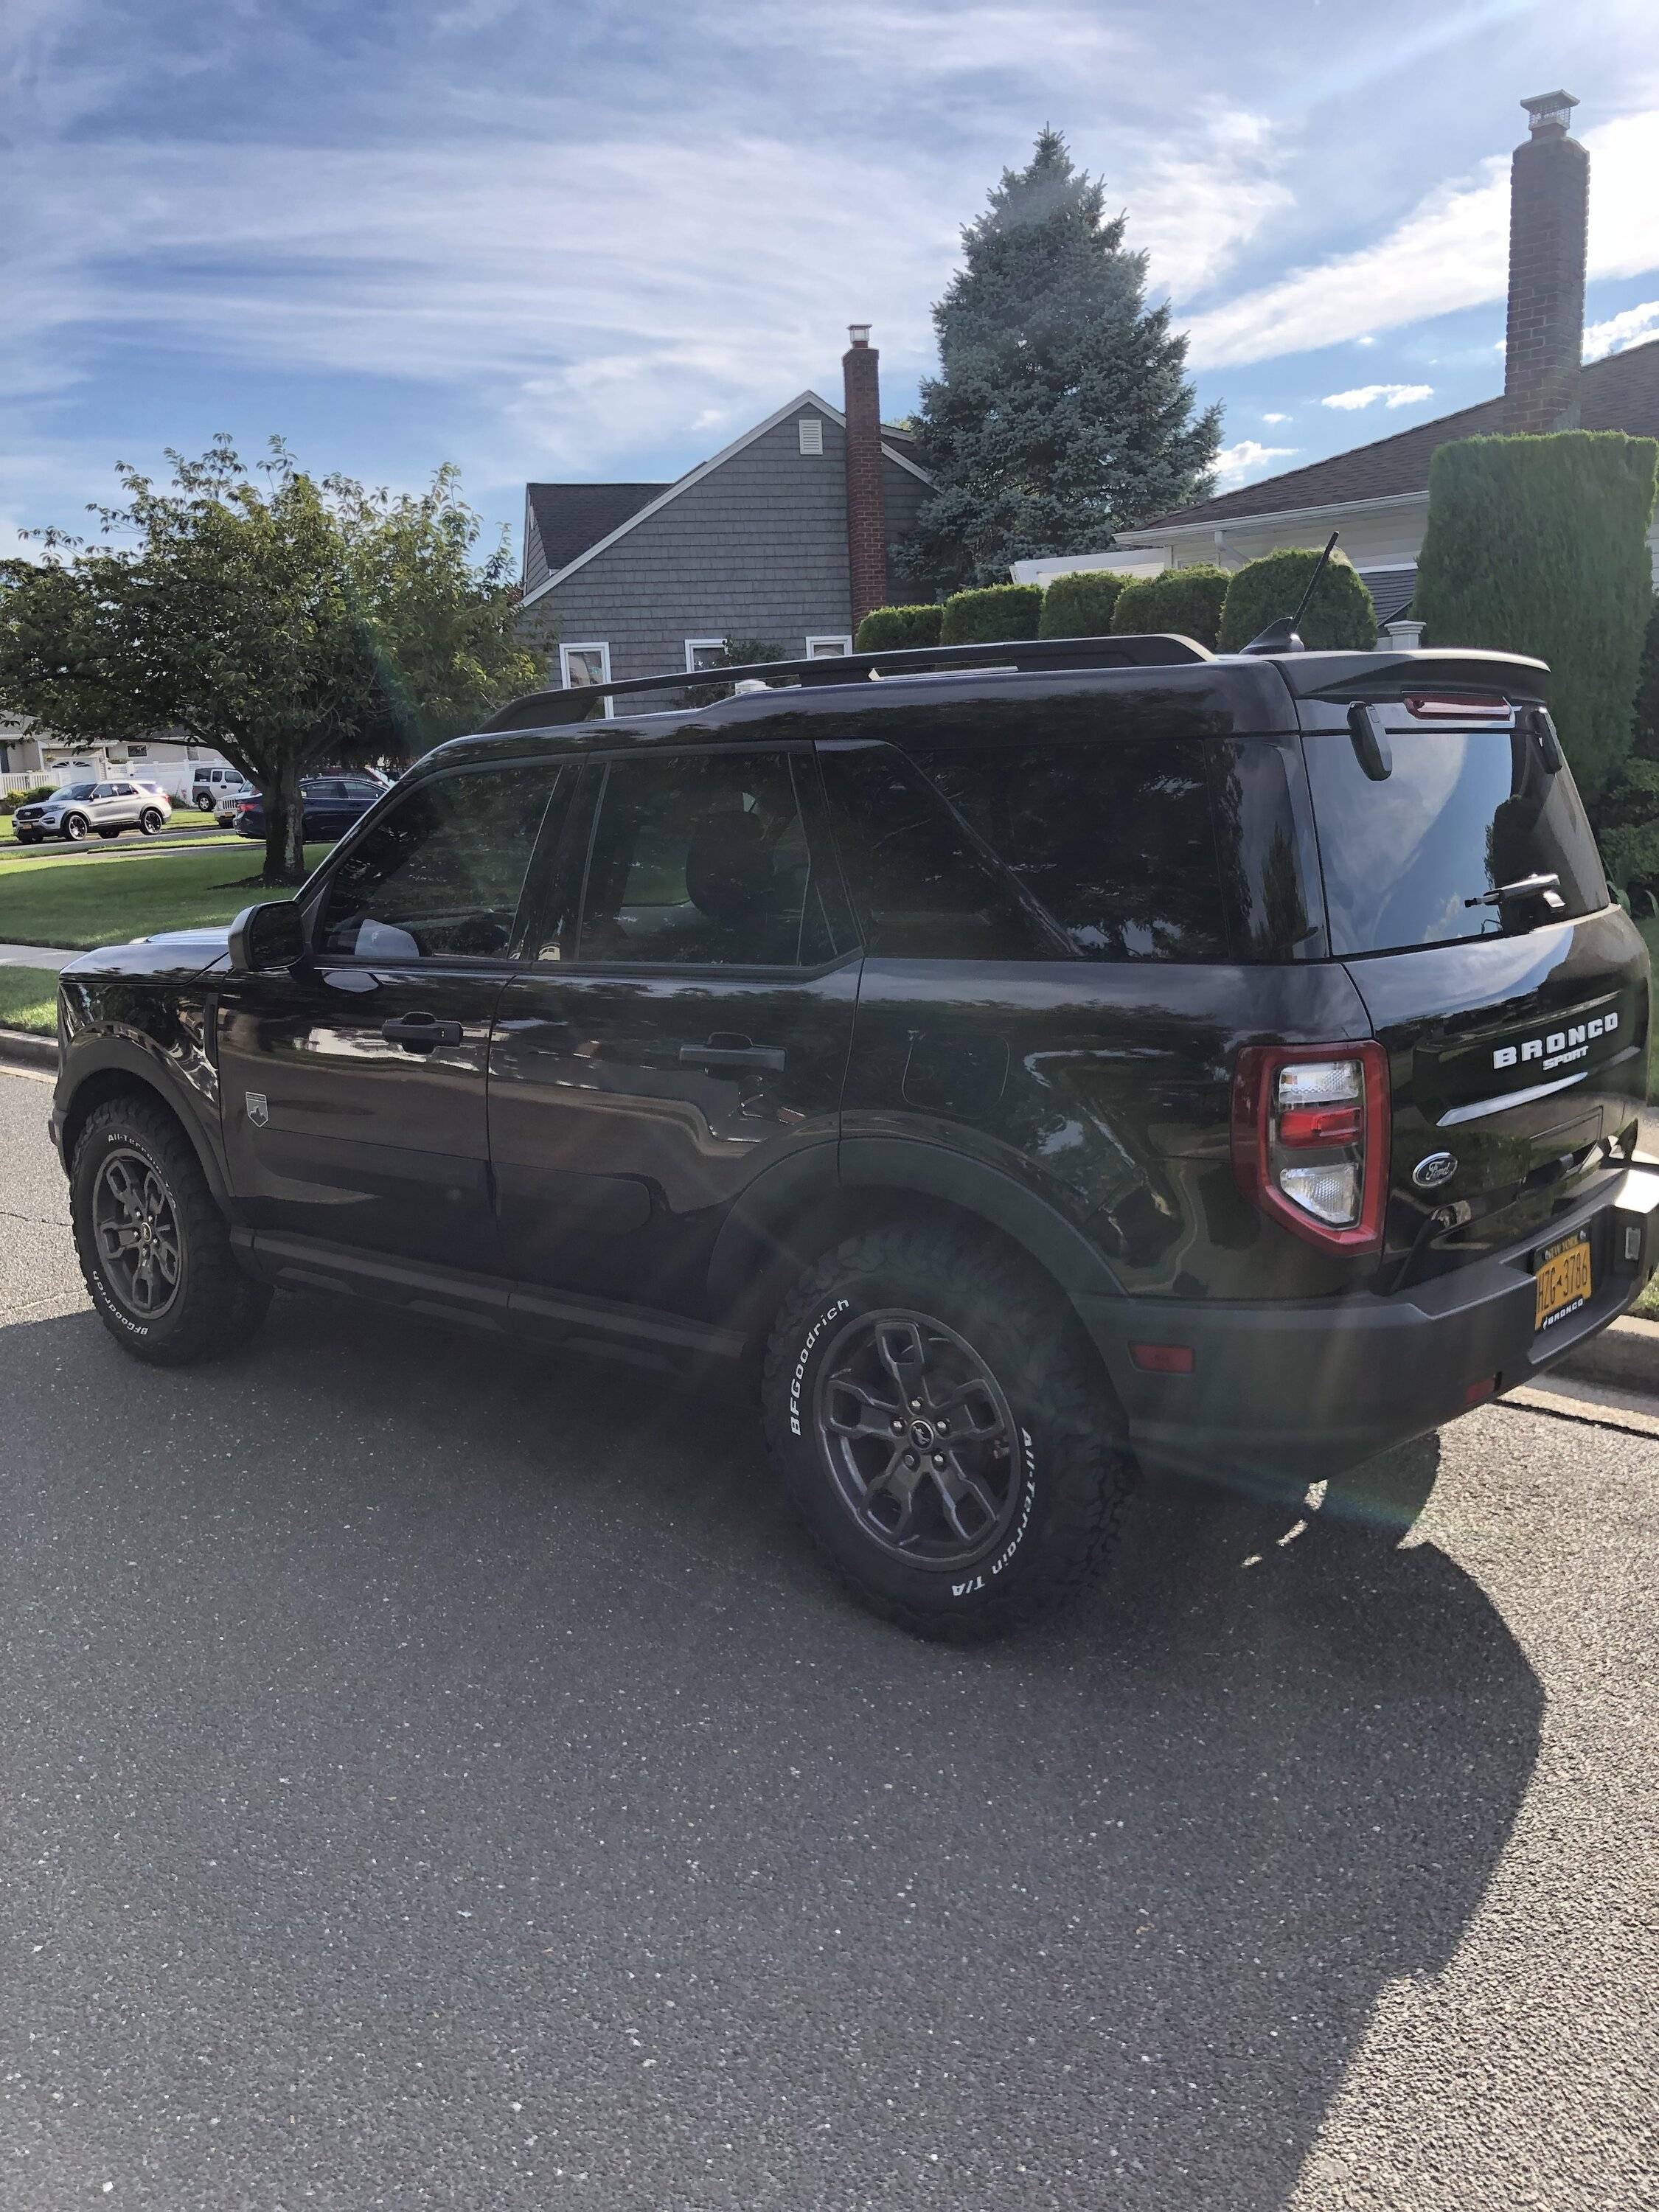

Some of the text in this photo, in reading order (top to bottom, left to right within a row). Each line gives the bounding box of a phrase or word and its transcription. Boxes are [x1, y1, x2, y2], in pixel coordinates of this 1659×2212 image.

[1493, 1012, 1618, 1069] BRONCO
[1543, 1046, 1589, 1071] SPORT
[93, 1270, 149, 1335] BFGoodrich
[1548, 1298, 1584, 1326] BRONCO
[790, 1299, 849, 1436] BFGoodrich
[952, 1427, 1035, 1596] All-Terrain T/A
